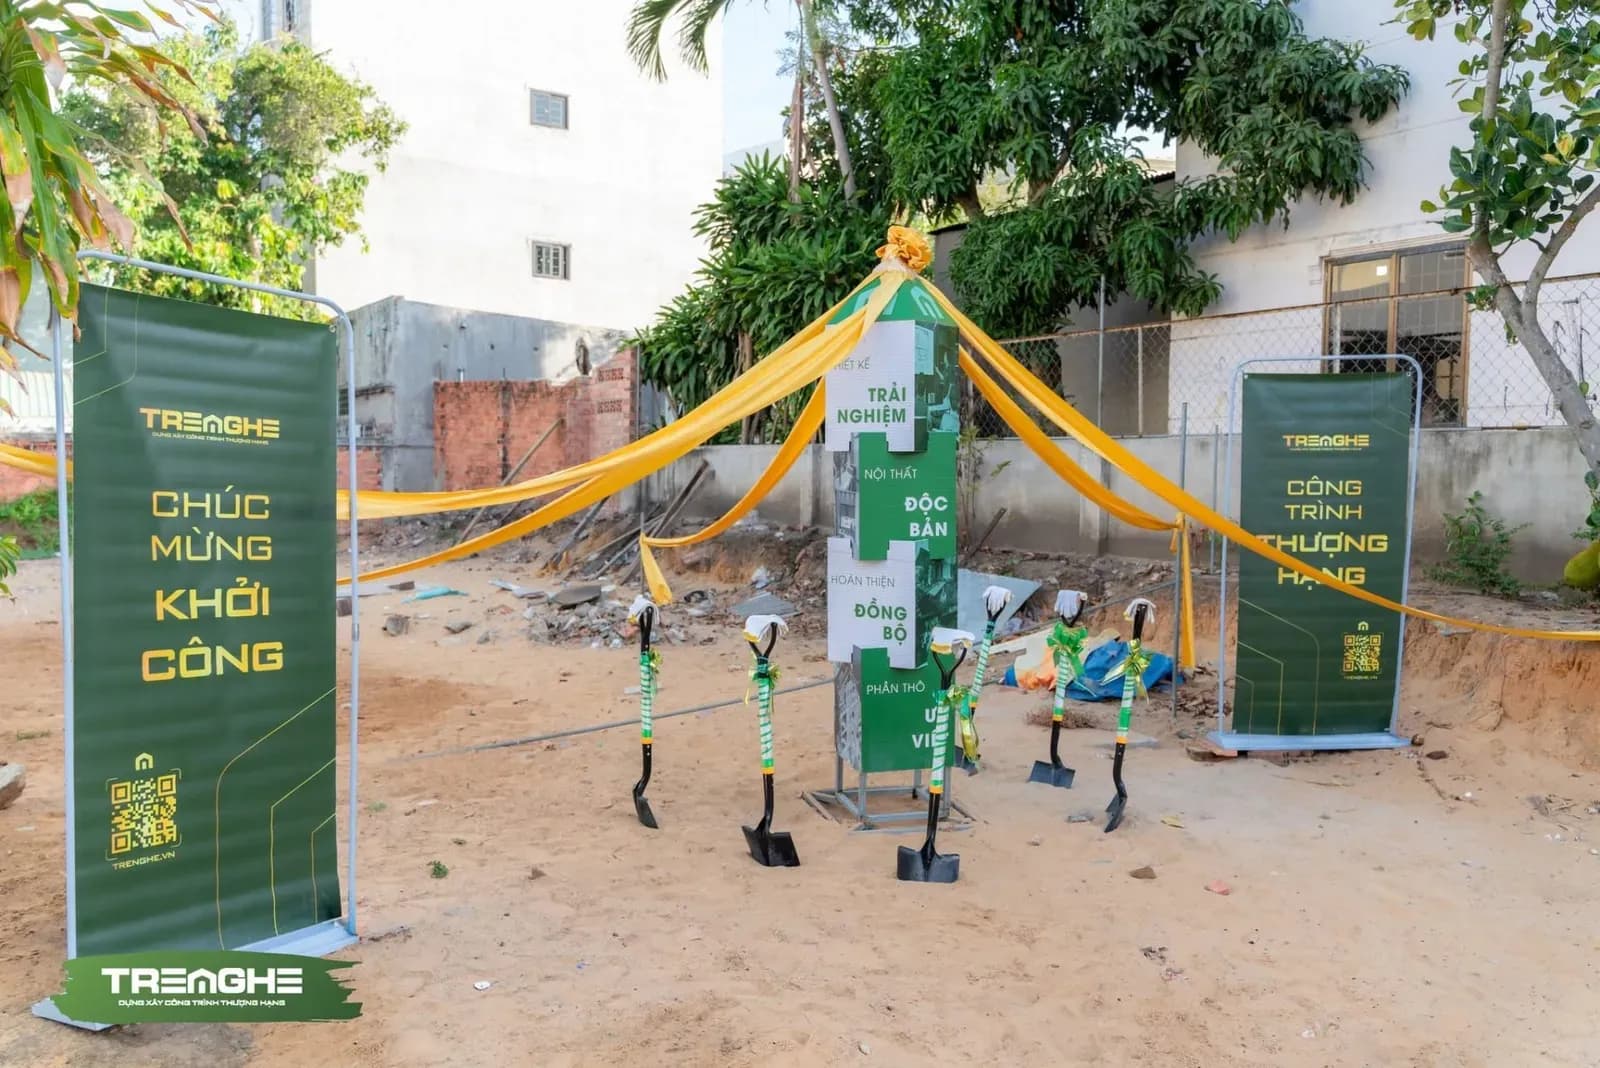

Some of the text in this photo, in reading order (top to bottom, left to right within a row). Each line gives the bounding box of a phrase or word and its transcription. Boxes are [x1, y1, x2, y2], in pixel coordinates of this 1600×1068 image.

[867, 381, 906, 402] TRẢI
[837, 404, 906, 427] NGHIỆM
[864, 465, 918, 482] NỘI THẤT
[1287, 475, 1362, 496] CÔNG
[152, 485, 270, 520] CHÚC
[904, 492, 948, 516] ĐỘC
[1285, 500, 1363, 520] TRÌNH
[910, 516, 948, 537] BẢN
[151, 527, 273, 561] MỪNG
[155, 577, 270, 621] KHỞI
[854, 597, 907, 620] ĐỒNG
[883, 623, 907, 646] BỘ
[142, 636, 284, 681] CÔNG
[902, 679, 926, 693] THÔ
[112, 850, 176, 870] TRENGHE.VN
